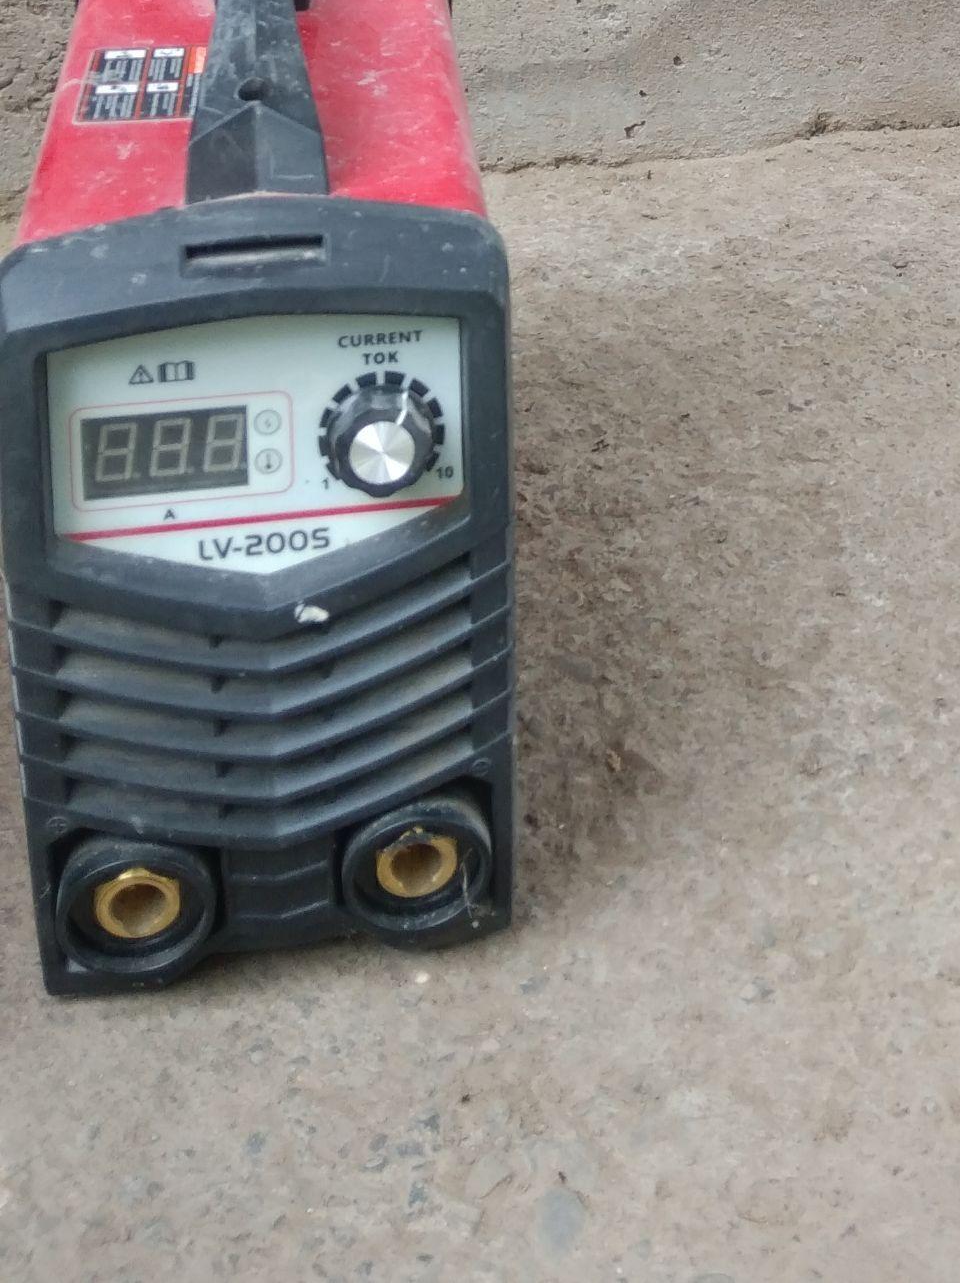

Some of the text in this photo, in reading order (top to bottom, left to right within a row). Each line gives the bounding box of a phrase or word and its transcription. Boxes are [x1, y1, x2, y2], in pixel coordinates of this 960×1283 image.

[338, 330, 423, 348] CURRENT
[436, 466, 454, 479] 10
[163, 508, 176, 520] A
[198, 527, 330, 561] LV-200S
